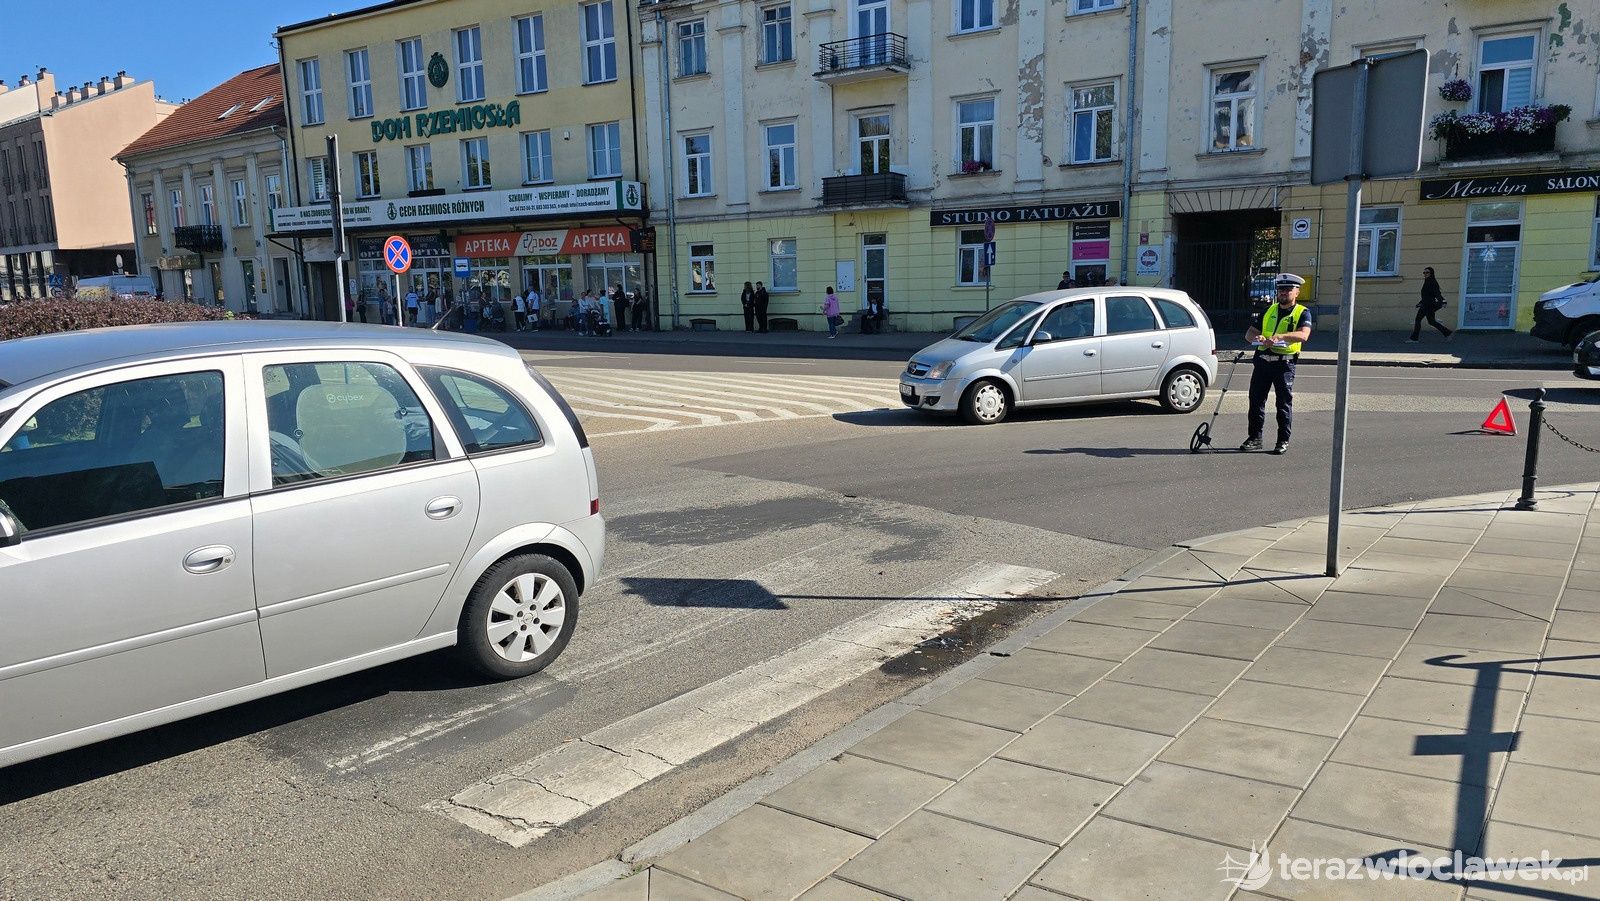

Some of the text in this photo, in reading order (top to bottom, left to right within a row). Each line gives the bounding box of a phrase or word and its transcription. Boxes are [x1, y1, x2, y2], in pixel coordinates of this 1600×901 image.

[371, 100, 521, 143] DOM RZEMIOSŁA
[508, 193, 533, 203] SZKOLIMY
[538, 190, 570, 201] WSPIERAMY
[576, 187, 610, 198] DORADZAMY
[1426, 176, 1600, 199] Marilyn SALON
[399, 200, 485, 217] CECH RZEMIOSŁ RÓŻNYCH
[942, 203, 1109, 224] STUDIO TATUAŻU
[464, 239, 510, 253] APTEKA
[538, 237, 558, 247] DOZ
[572, 233, 625, 248] APTEKA
[336, 393, 364, 404] cybex
